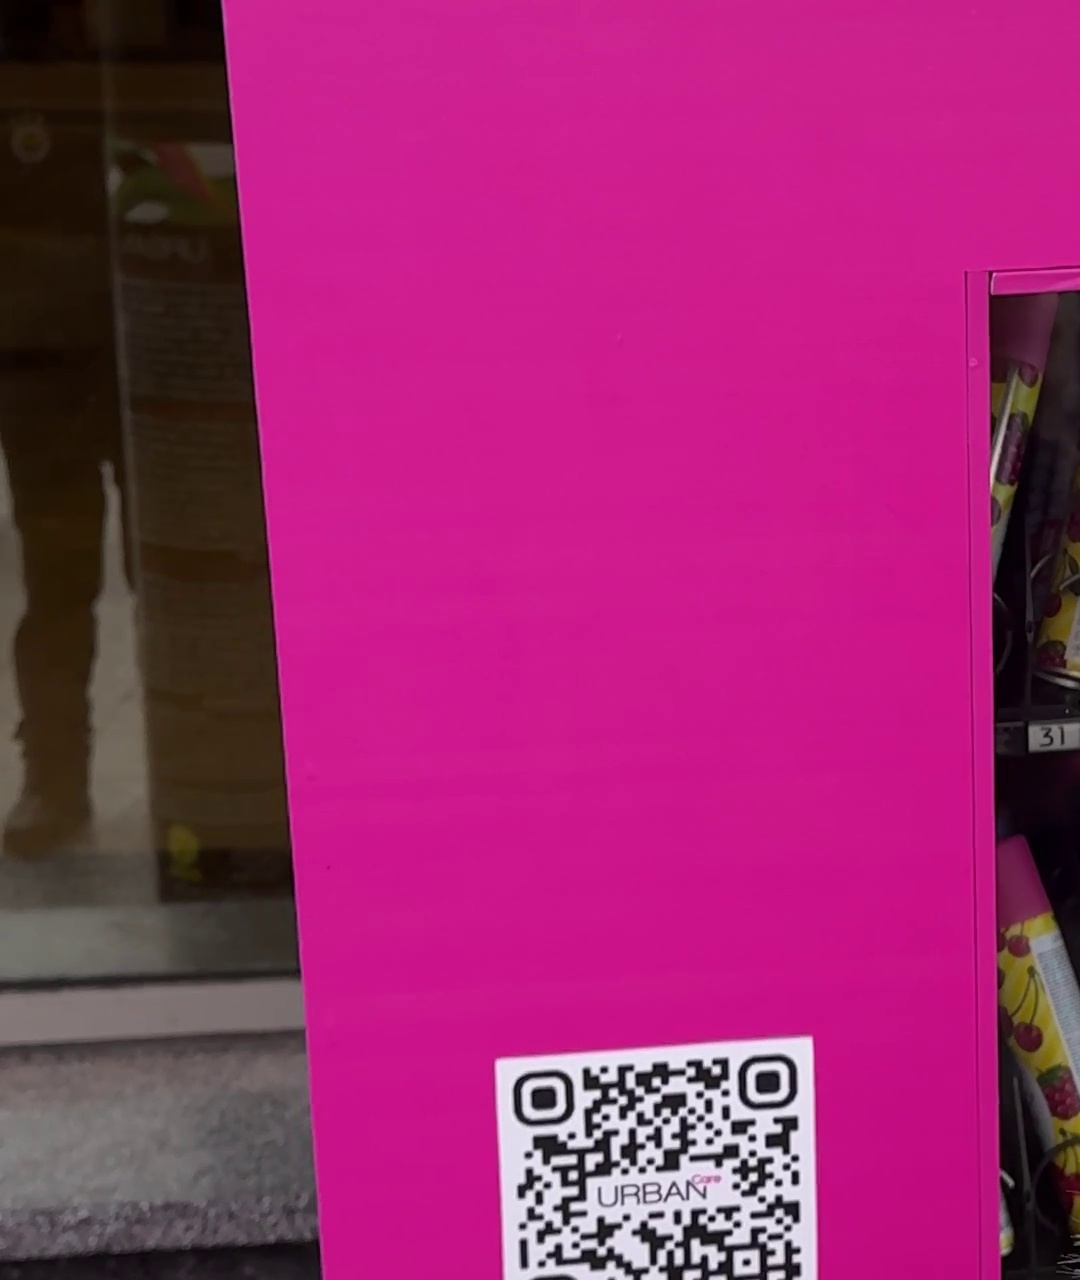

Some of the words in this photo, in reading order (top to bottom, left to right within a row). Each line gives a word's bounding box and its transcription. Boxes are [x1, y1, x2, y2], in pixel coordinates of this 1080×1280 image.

[1039, 726, 1065, 747] 31
[691, 1174, 722, 1185] Care
[597, 1180, 707, 1208] URBAN
